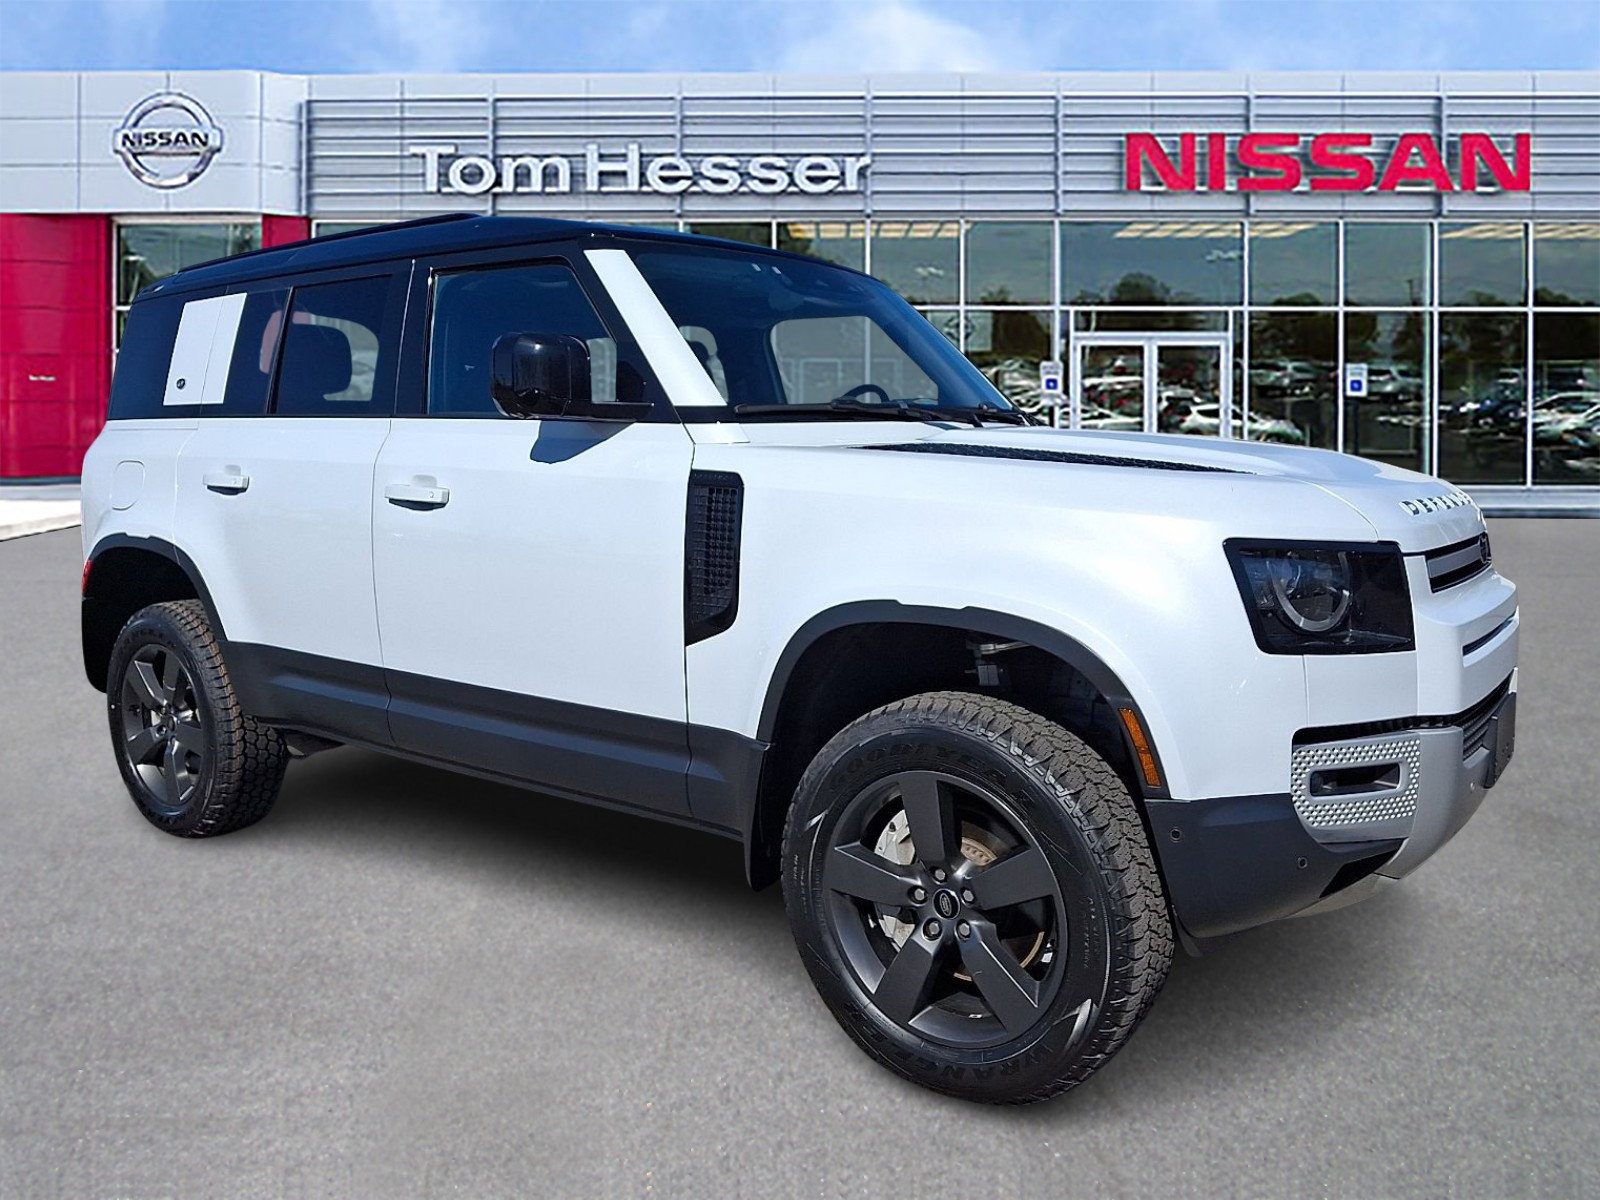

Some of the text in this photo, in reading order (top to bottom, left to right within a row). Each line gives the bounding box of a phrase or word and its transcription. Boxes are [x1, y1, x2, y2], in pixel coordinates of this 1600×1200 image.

[121, 131, 209, 148] NISSAN
[409, 142, 872, 194] Tom Hesser
[1124, 132, 1531, 192] NISSAN
[1398, 491, 1472, 517] DEFEND
